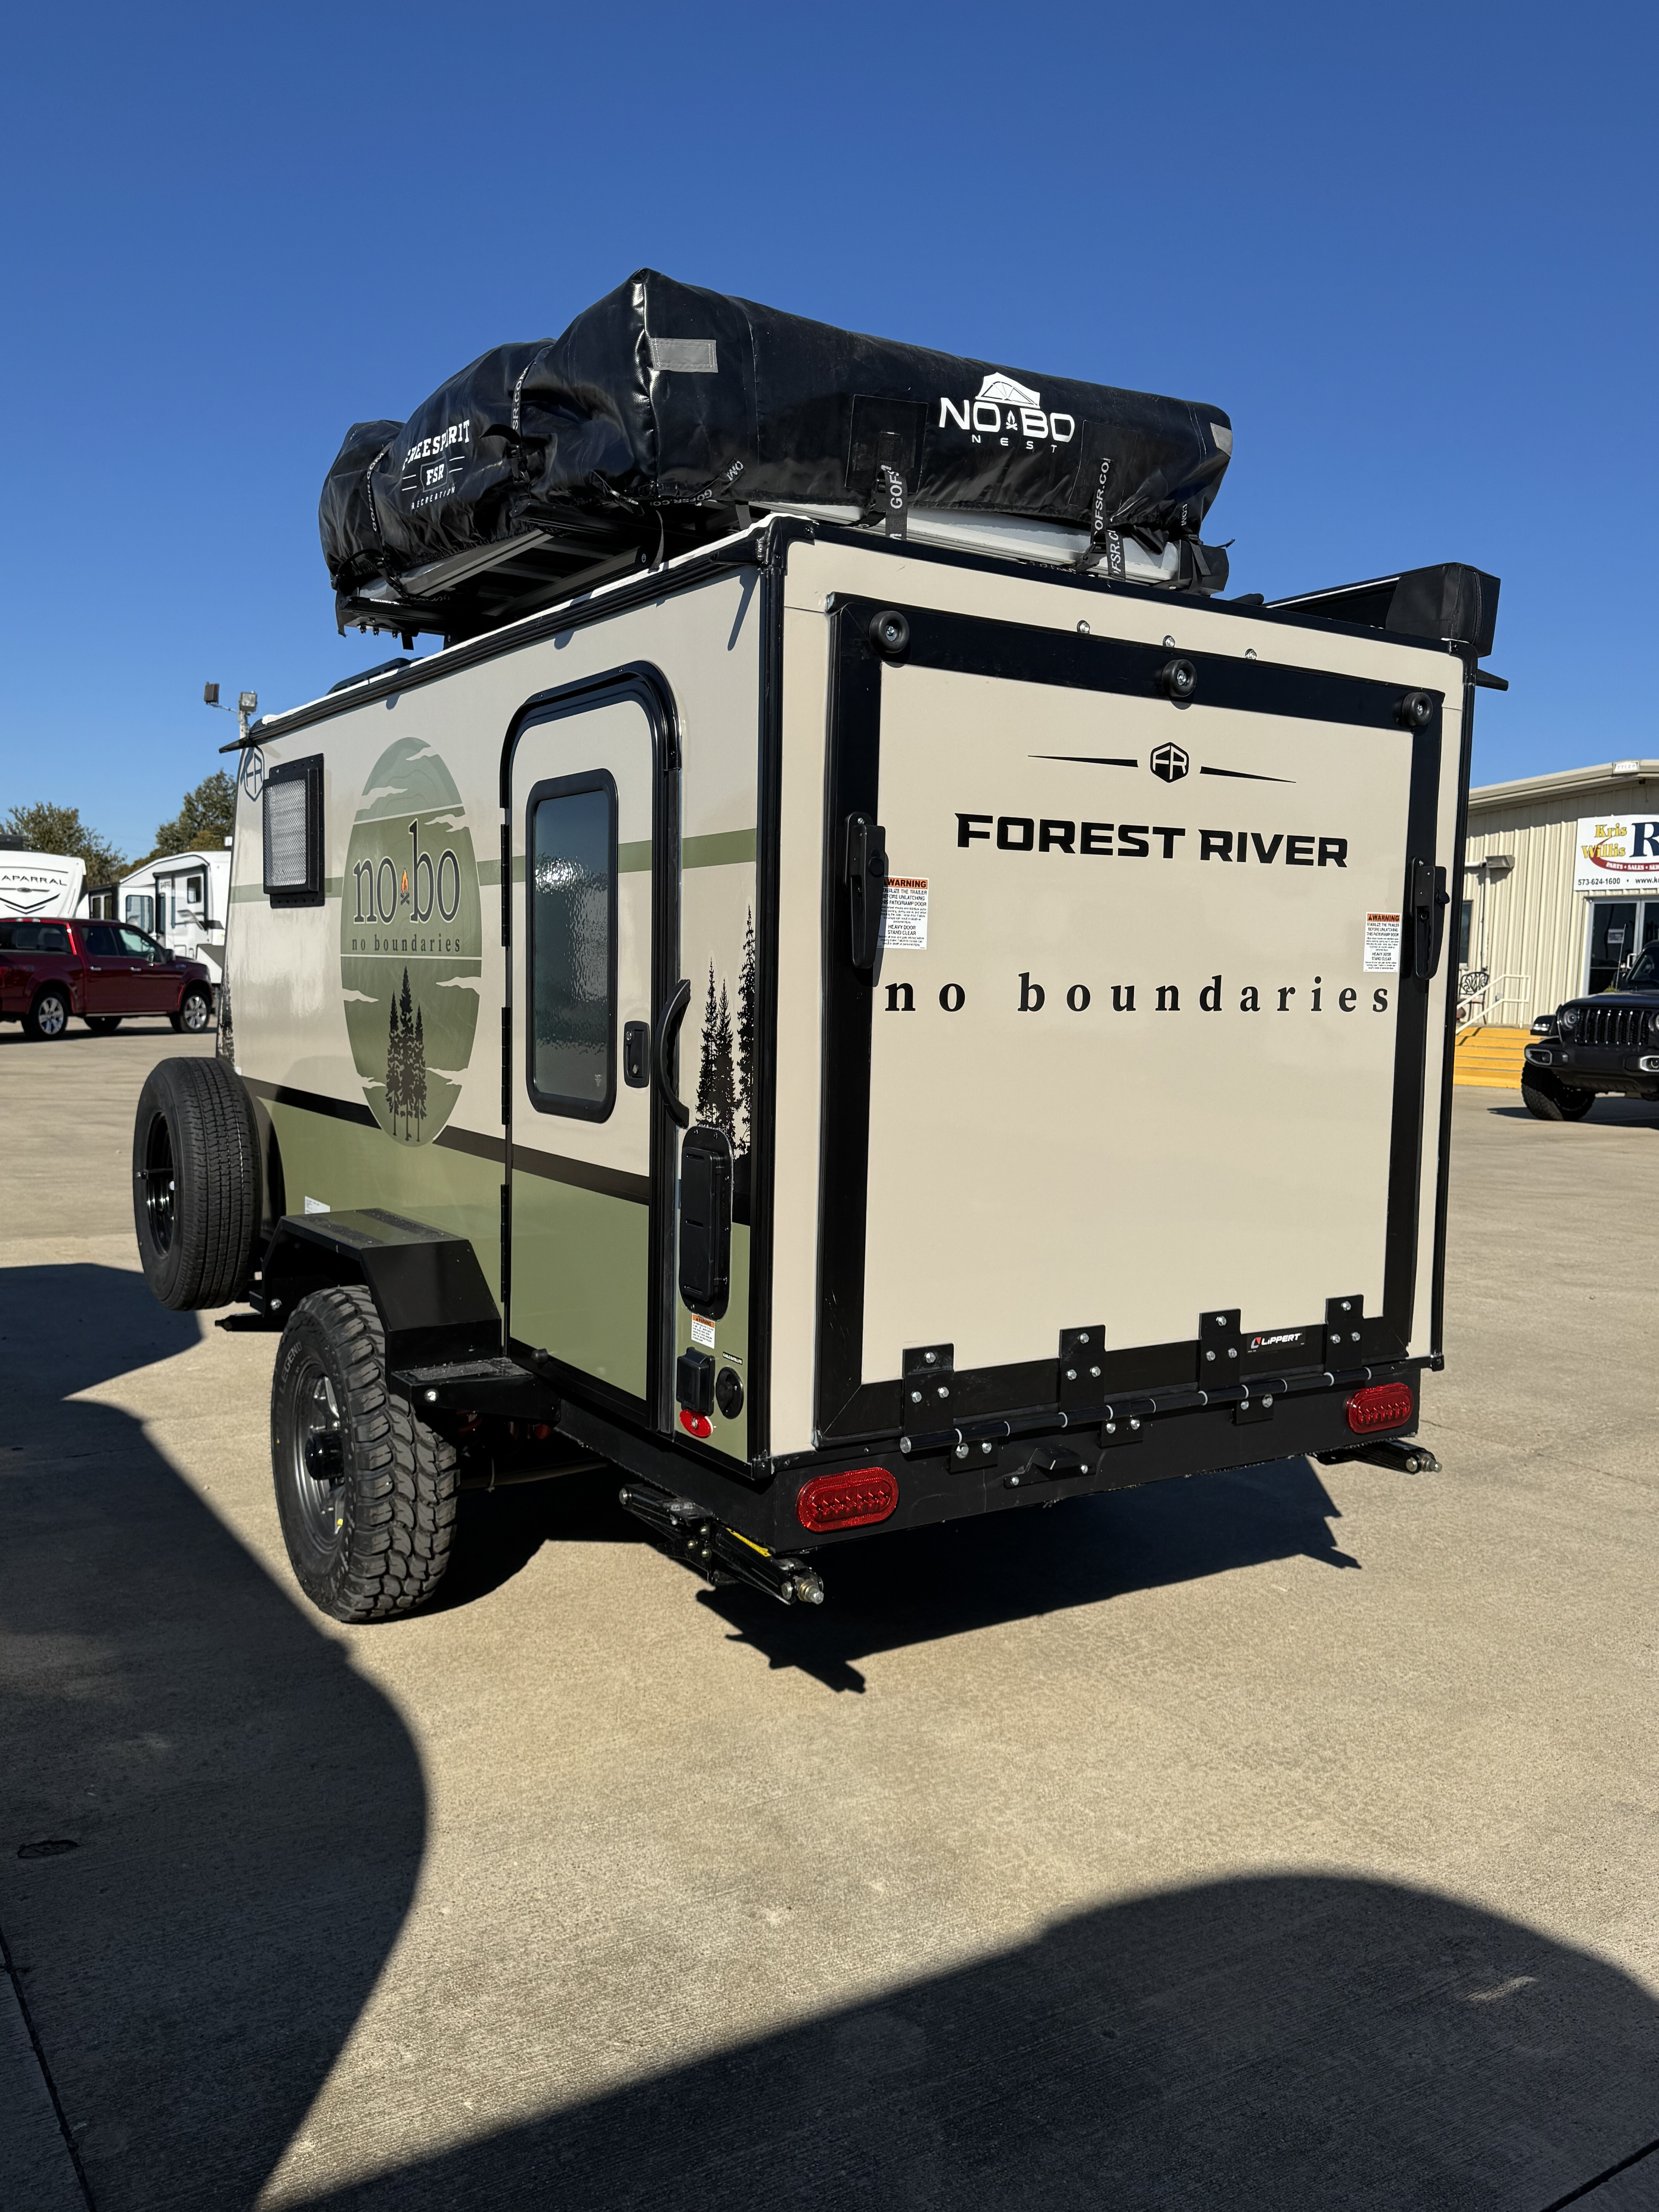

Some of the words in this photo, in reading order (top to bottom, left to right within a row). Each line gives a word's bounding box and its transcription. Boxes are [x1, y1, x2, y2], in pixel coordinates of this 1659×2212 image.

[972, 434, 1057, 453] NEST
[426, 464, 445, 486] FSR
[411, 486, 456, 510] RECREATION
[1094, 458, 1113, 536] OFSR.CO
[955, 813, 1186, 859] FOREST
[1198, 829, 1348, 867] RIVER
[1594, 823, 1627, 838] Kris
[1581, 843, 1626, 859] Willis
[888, 878, 926, 888] WARNING
[1578, 878, 1620, 886] 573-624-1600
[352, 938, 366, 951] no
[374, 933, 460, 952] boundaries
[885, 982, 965, 1012] no
[1017, 972, 1388, 1012] boundaries
[279, 1341, 302, 1395] LEGEND
